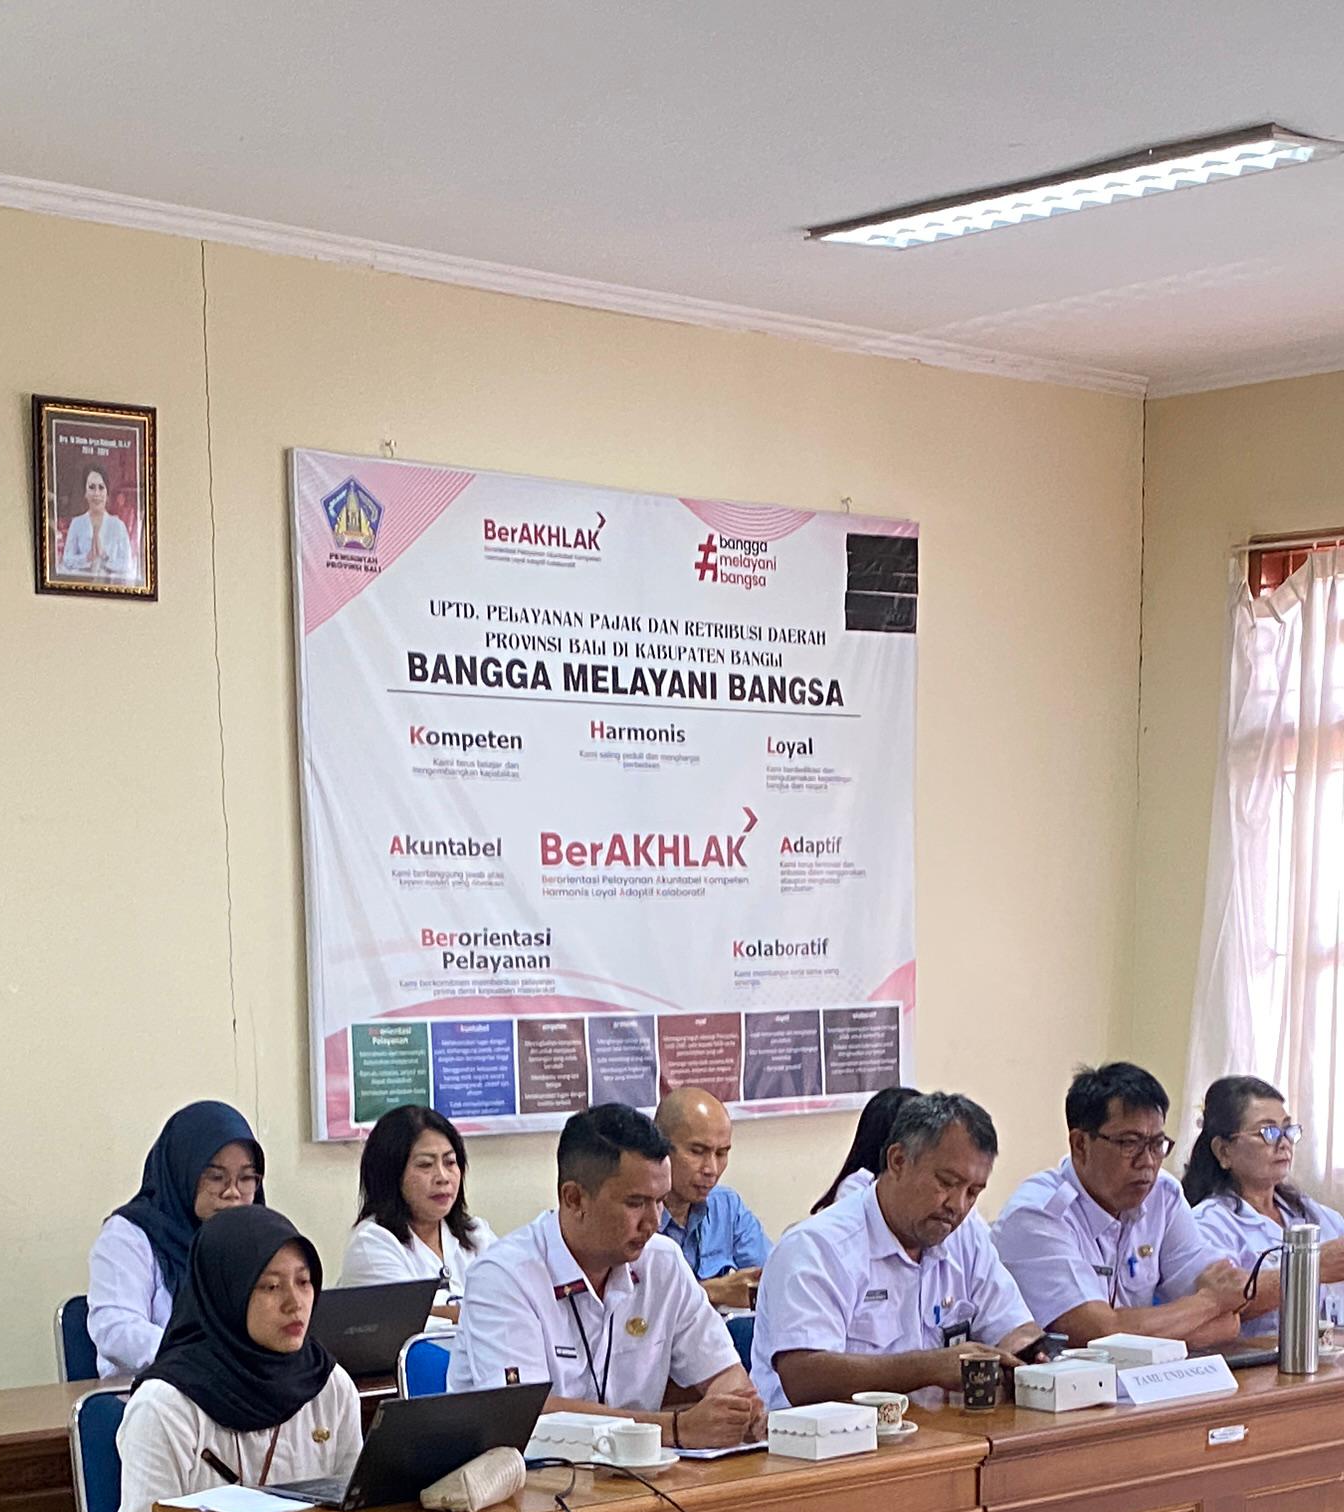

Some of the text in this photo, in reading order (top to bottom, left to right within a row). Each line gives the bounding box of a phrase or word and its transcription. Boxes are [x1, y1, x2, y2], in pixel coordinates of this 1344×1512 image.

[483, 519, 600, 551] BerAKHLAK
[719, 534, 768, 555] bangga
[719, 555, 777, 573] melayani
[720, 571, 767, 590] bangsa
[429, 599, 826, 646] UPTD. PELAYANAN PAJAK DAN RETRIBUSI DAERAH
[485, 631, 783, 668] PROVINSI BALI DI KABUPATEN BANGLI
[407, 651, 845, 707] BANGGA MELAYANI BANGSA
[409, 725, 523, 752] Kompeten
[590, 720, 686, 743] Harmonis
[767, 736, 813, 759] Loyal
[390, 835, 502, 857] Akuntabel
[540, 831, 748, 868] BerAKHLAK
[780, 836, 843, 857] Adaptif
[542, 875, 600, 885] Berorientasi
[602, 875, 654, 887] Pelayanan
[656, 875, 702, 885] Akuntabel
[542, 888, 589, 897] Harmonis
[591, 888, 617, 899] Loyal
[619, 888, 654, 899] Adaptif
[421, 928, 551, 947] Berorientasi
[733, 937, 829, 957] Kolaboratif
[442, 951, 551, 973] Pelayanan
